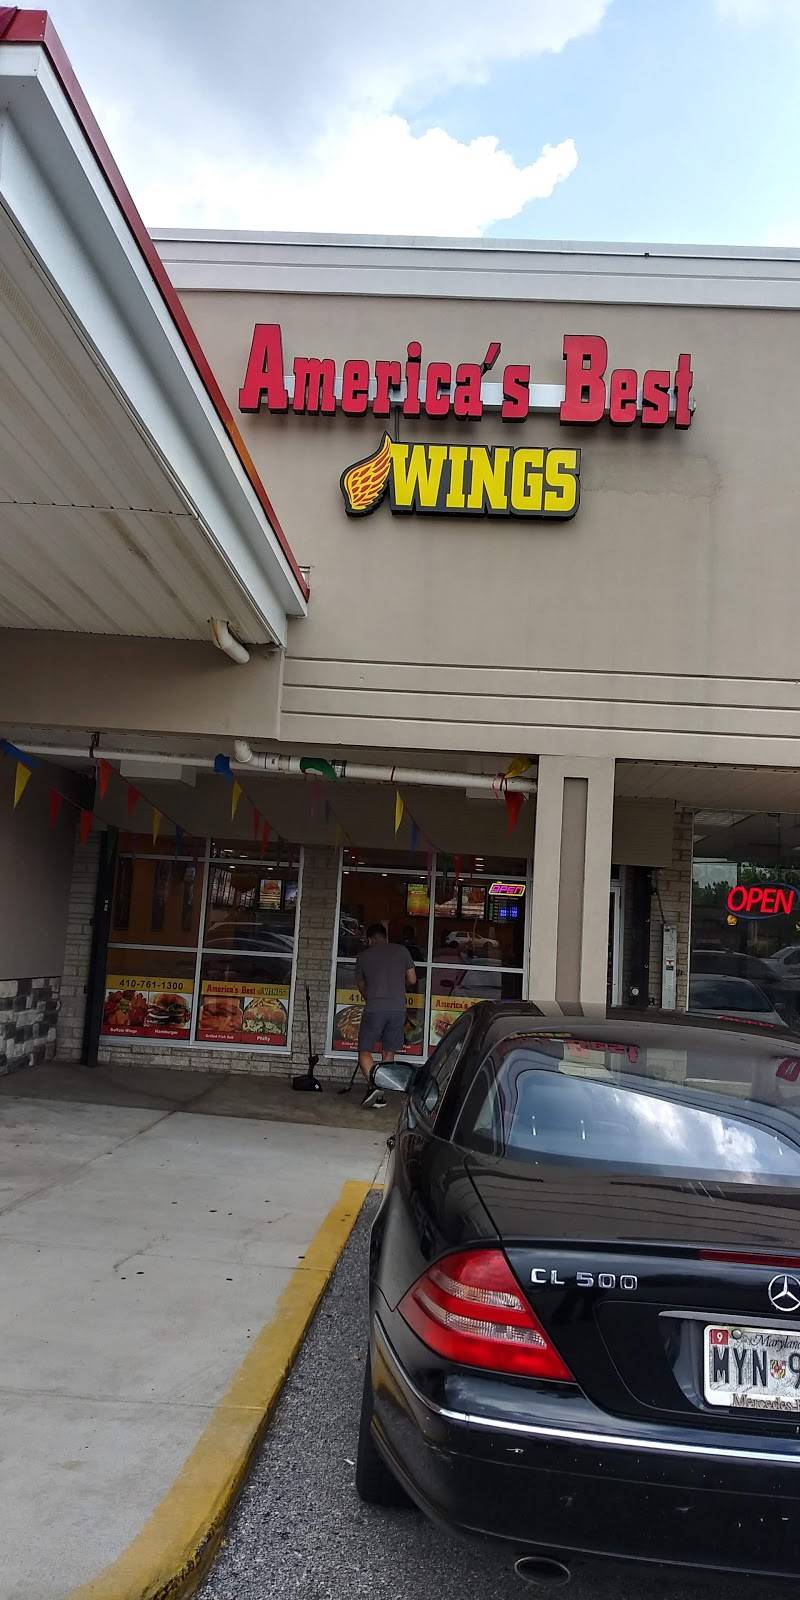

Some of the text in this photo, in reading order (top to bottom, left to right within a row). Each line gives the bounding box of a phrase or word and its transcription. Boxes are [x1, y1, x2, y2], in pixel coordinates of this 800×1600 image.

[239, 323, 694, 428] America's Best
[390, 442, 577, 513] WINGS
[491, 885, 523, 895] OPEN
[727, 885, 795, 915] OPEN
[119, 978, 184, 990] 410-761-1300
[206, 984, 239, 994] America's
[241, 985, 256, 995] Best
[530, 1268, 638, 1291] CL 500
[716, 1332, 723, 1342] 9
[712, 1345, 768, 1388] MYN
